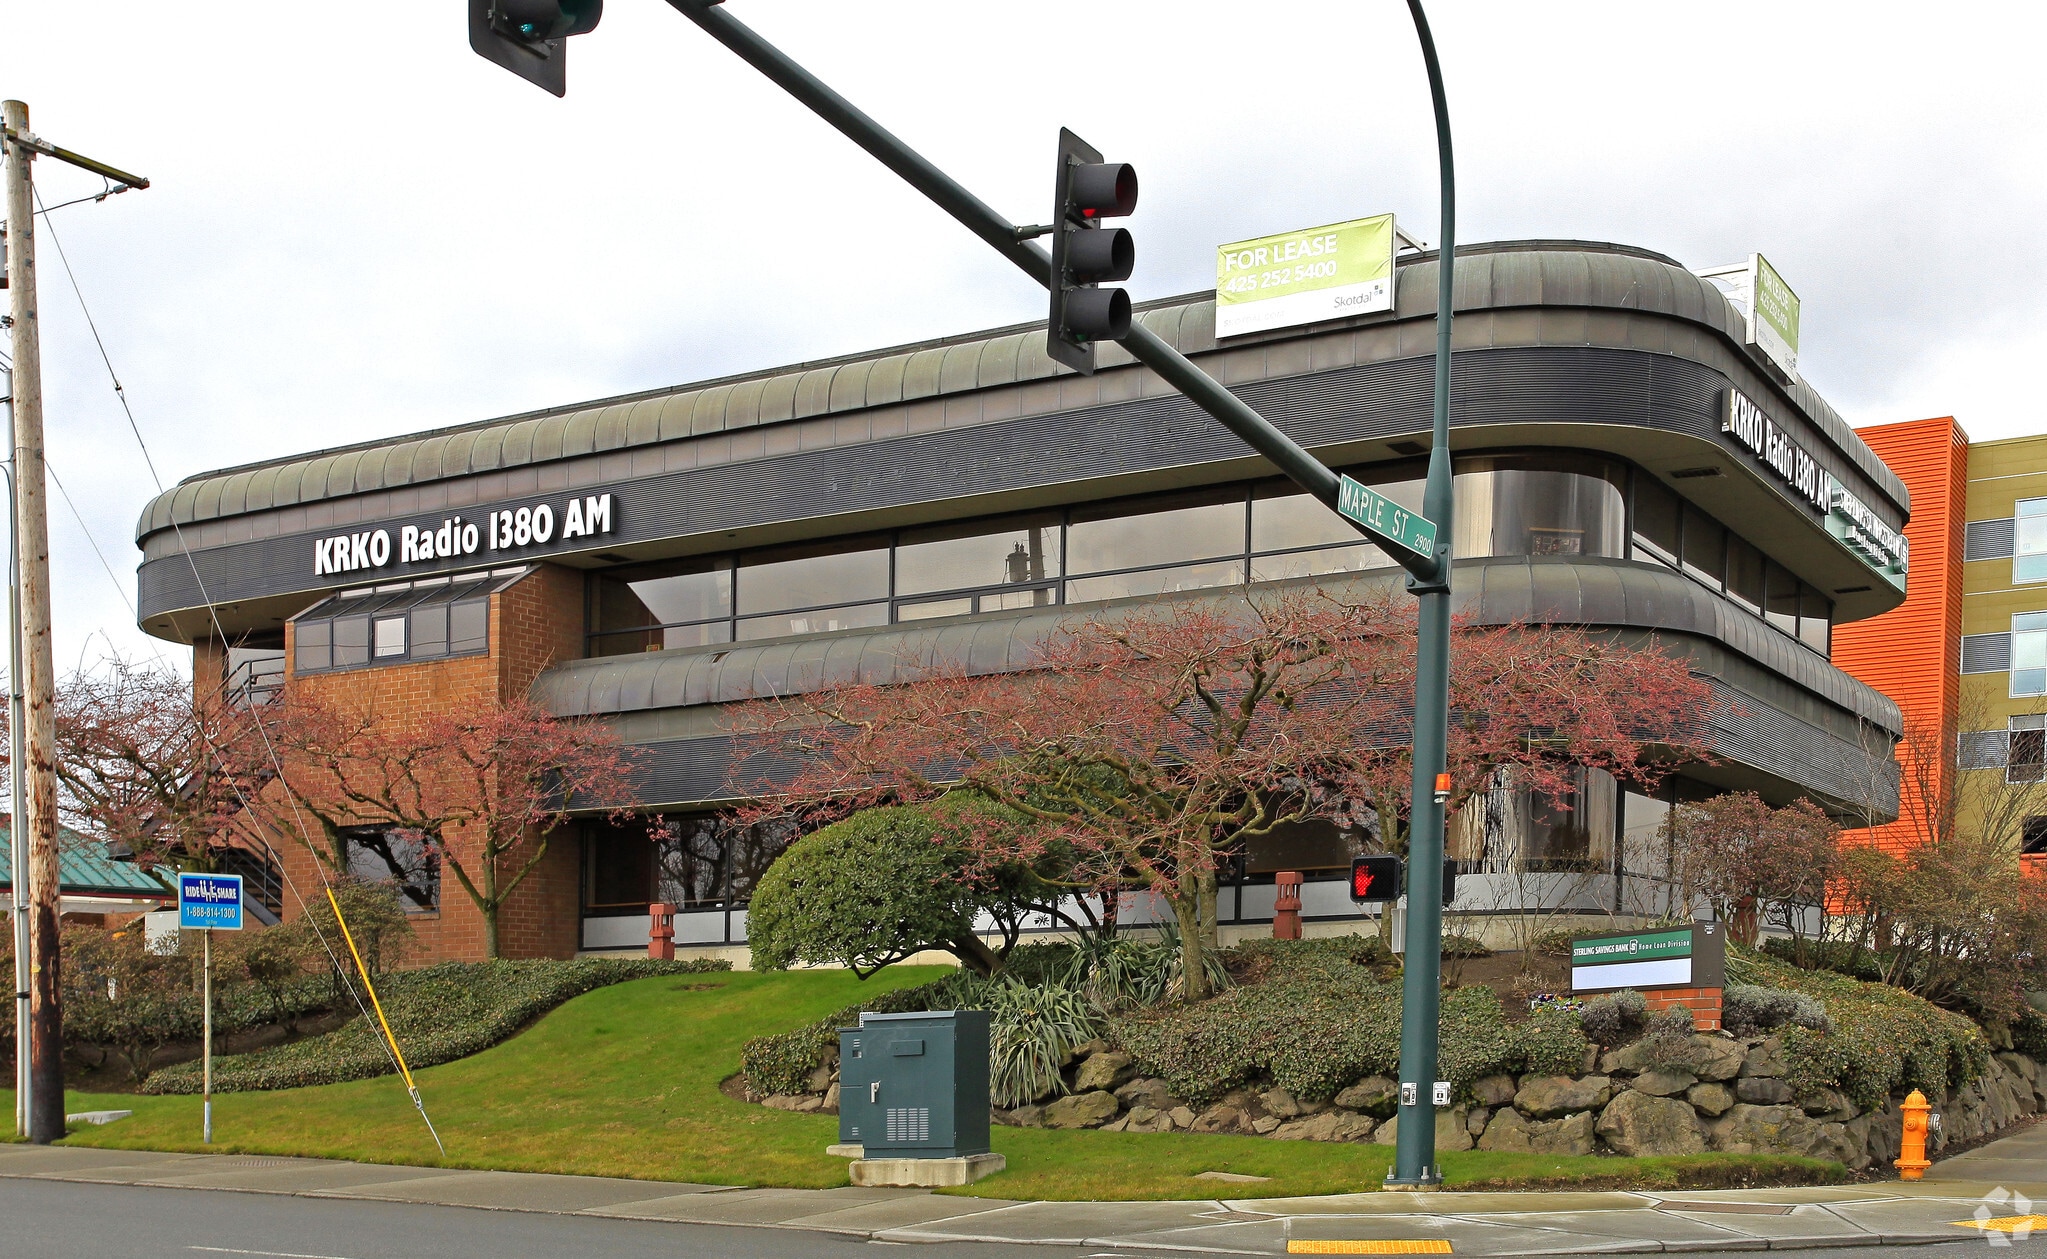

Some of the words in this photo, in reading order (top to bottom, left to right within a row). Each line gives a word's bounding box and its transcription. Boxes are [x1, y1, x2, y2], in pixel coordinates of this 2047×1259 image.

[1225, 247, 1269, 272] FOR
[1273, 234, 1338, 263] LEASE
[1225, 273, 1258, 293] 425
[1260, 267, 1291, 289] 252
[1294, 260, 1337, 282] 5400
[1333, 292, 1372, 308] Skotdal
[1731, 389, 1763, 454] KRKO
[1765, 418, 1793, 481] Radio
[1795, 446, 1816, 500] 1380
[1816, 468, 1832, 515] AM
[1341, 481, 1385, 528] MAPLE
[1392, 509, 1409, 539] ST
[1414, 533, 1432, 552] 2900
[314, 528, 391, 576] KRKO
[401, 515, 479, 563] Radio
[489, 503, 555, 550] 1380
[562, 493, 613, 539] AM
[185, 885, 200, 898] RIDE
[217, 887, 237, 899] SHARE
[186, 906, 236, 919] 1-888-814-1300
[1573, 946, 1595, 956] STERLING
[1595, 944, 1615, 954] SAVINGS
[1615, 943, 1629, 952] BANK
[1667, 940, 1690, 948] Division
